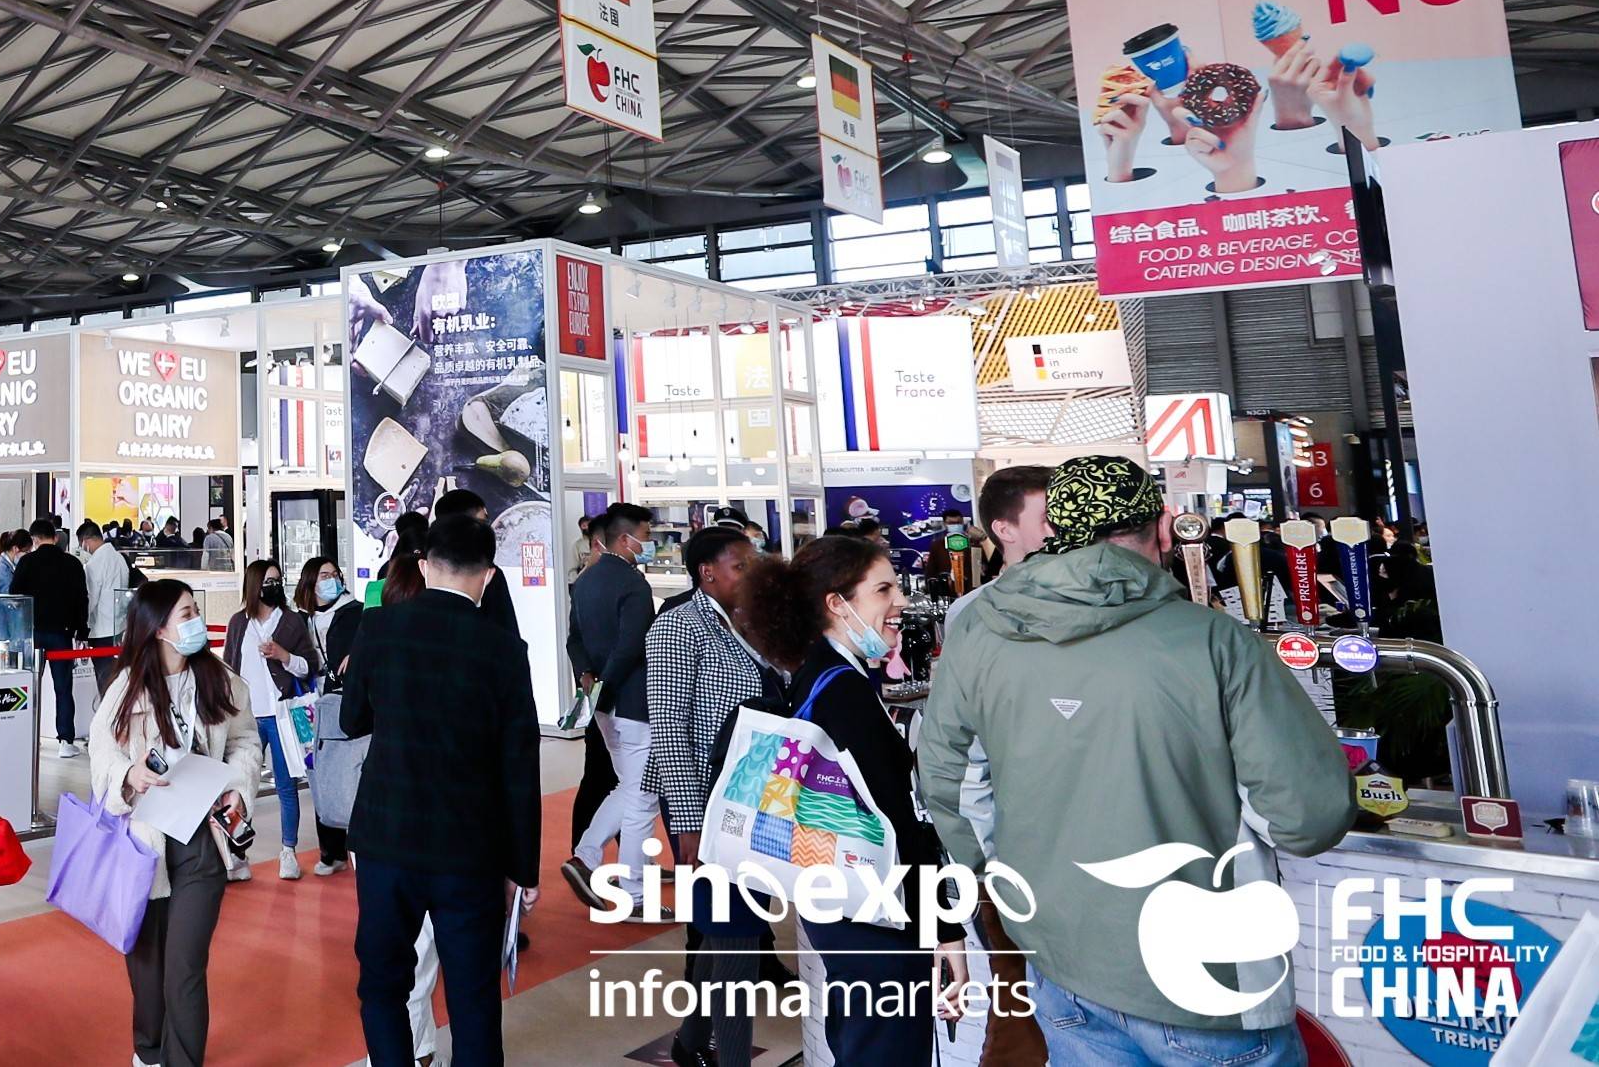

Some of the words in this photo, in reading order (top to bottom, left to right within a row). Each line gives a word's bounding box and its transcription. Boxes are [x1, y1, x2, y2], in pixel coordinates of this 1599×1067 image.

[614, 66, 640, 94] FHC
[615, 94, 643, 119] CHINA
[1138, 245, 1193, 264] FOOD
[1197, 243, 1212, 258] &
[1217, 234, 1319, 257] BEVERAGE,
[1143, 259, 1234, 281] CATERING
[1240, 256, 1312, 275] DESIGN
[1047, 344, 1079, 355] made
[7, 349, 37, 376] EU
[118, 349, 151, 377] WE
[181, 355, 207, 382] EU
[1049, 358, 1061, 367] in
[895, 369, 935, 384] Taste
[1051, 369, 1104, 381] Germany
[118, 380, 208, 411] ORGANIC
[664, 384, 701, 397] Taste
[895, 385, 946, 399] France
[135, 411, 193, 439] DAIRY
[1310, 482, 1323, 498] 6
[1360, 787, 1403, 801] Bush
